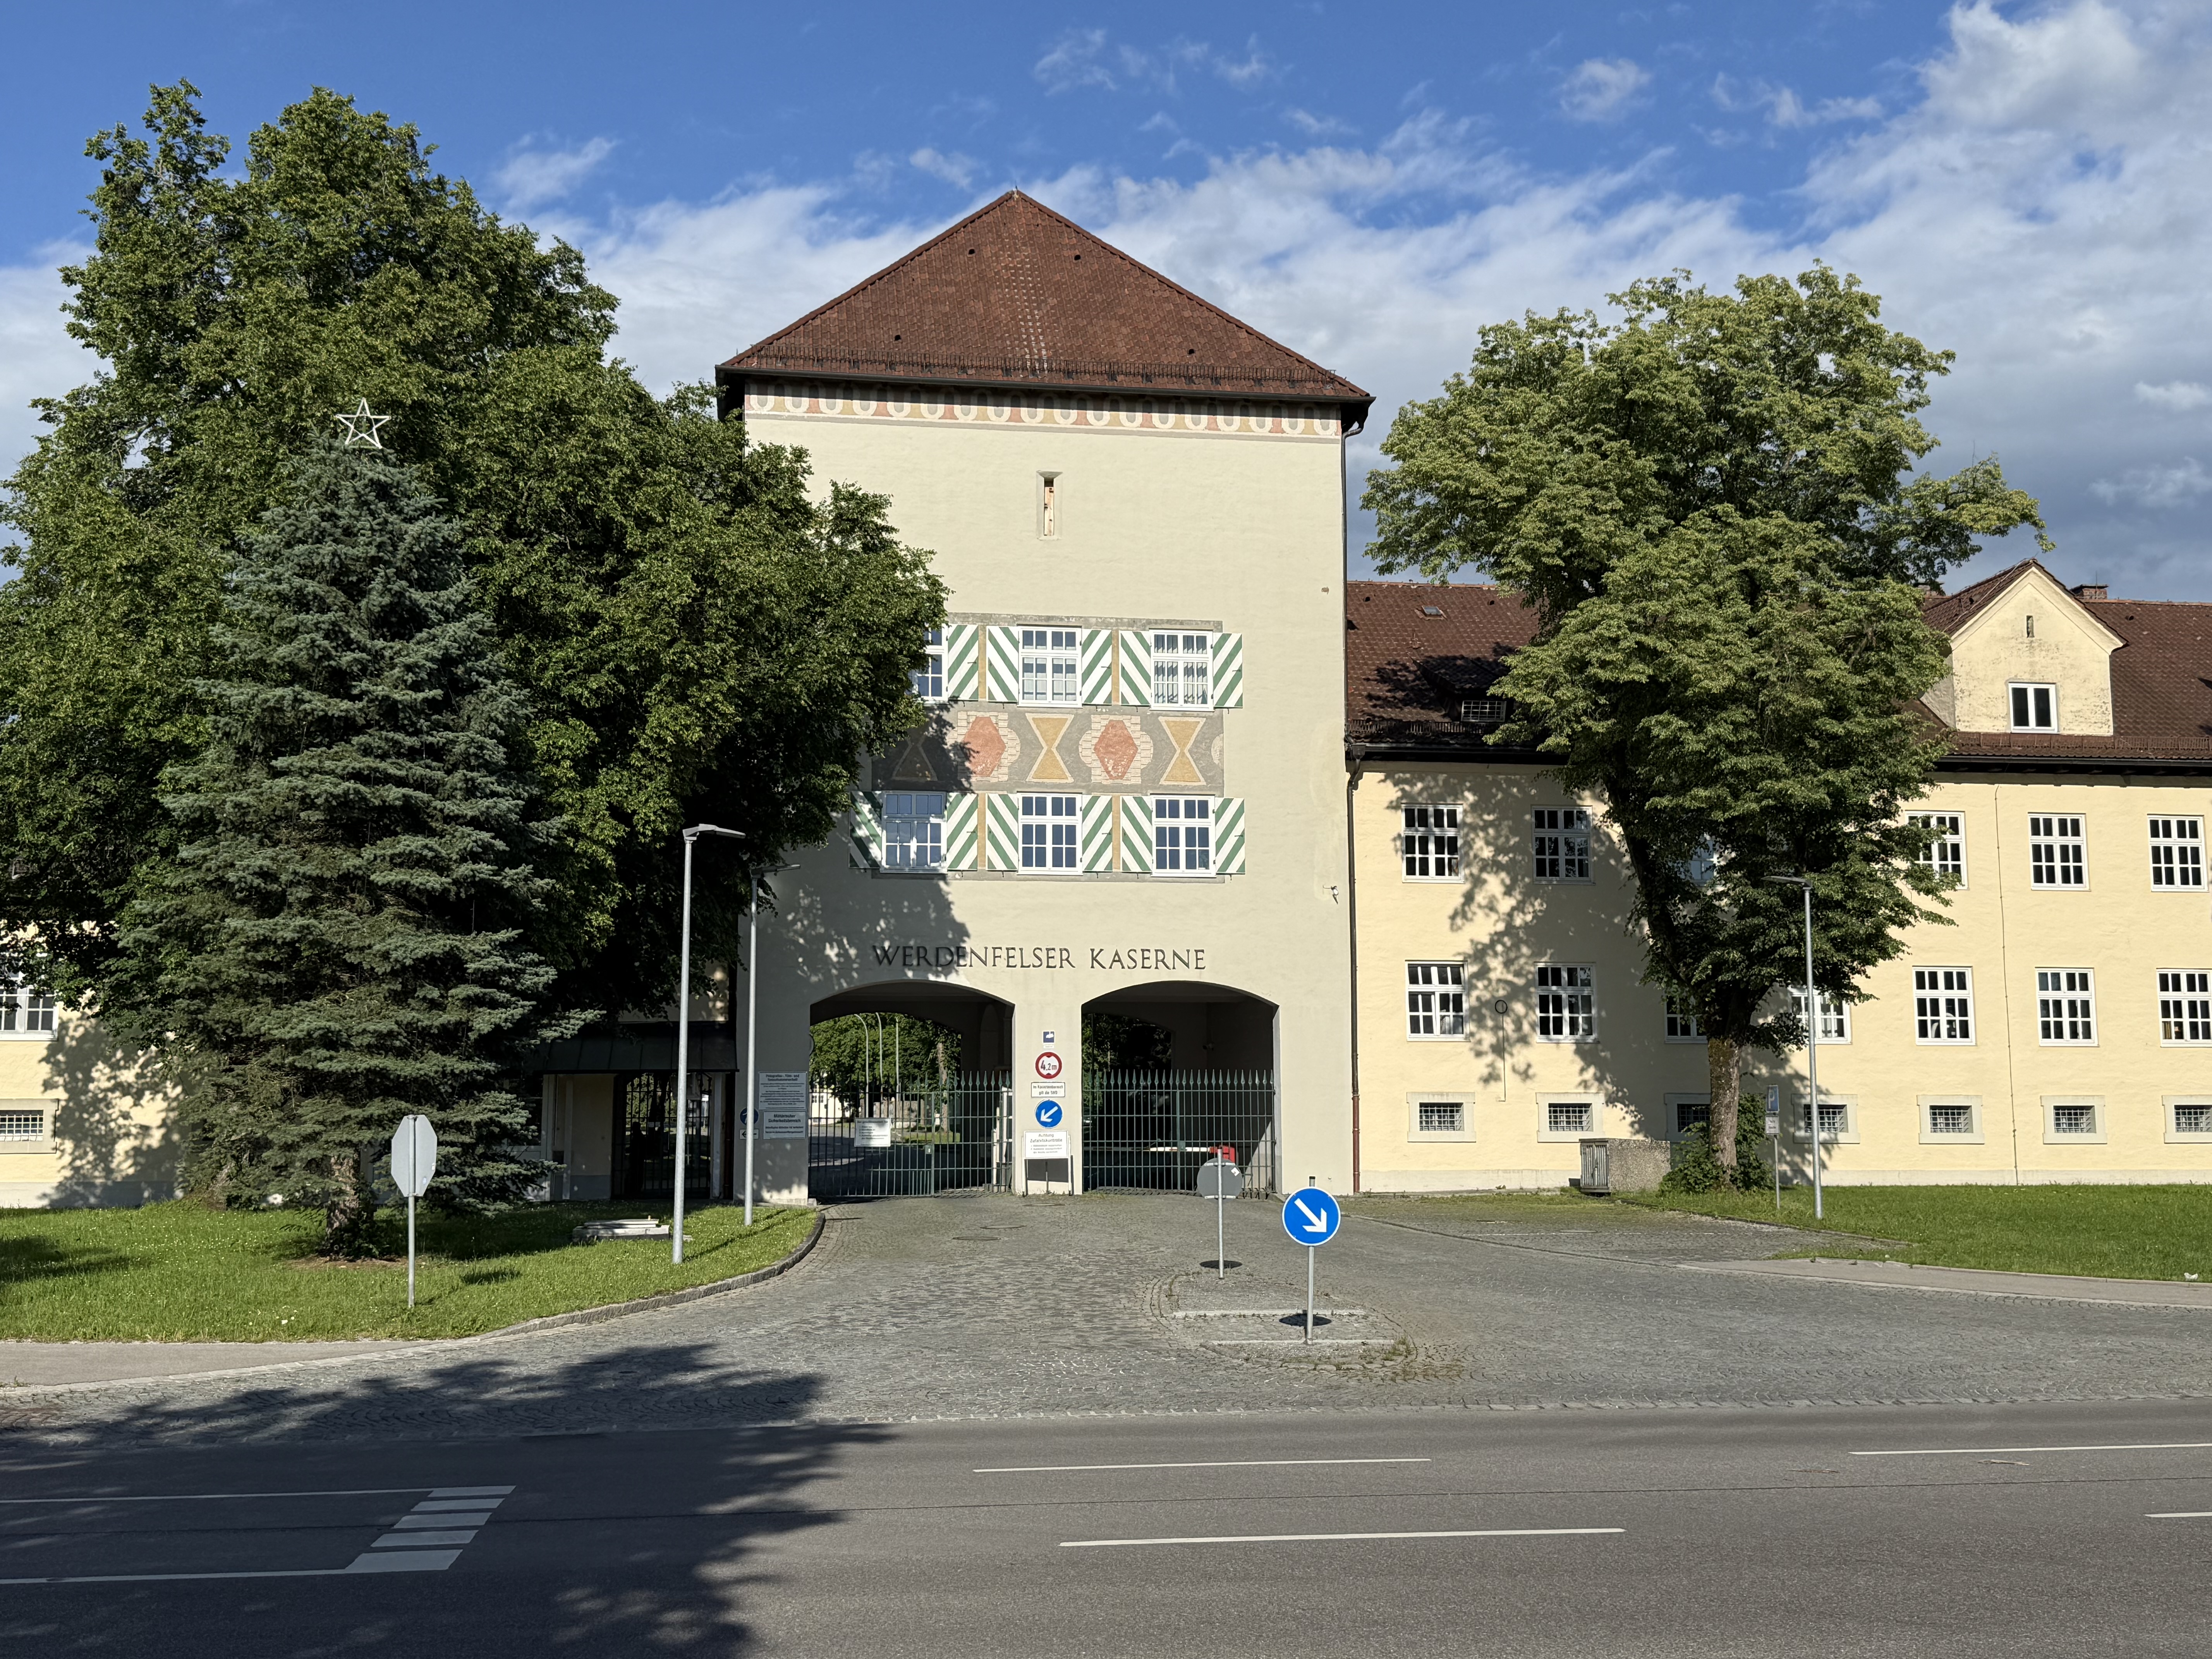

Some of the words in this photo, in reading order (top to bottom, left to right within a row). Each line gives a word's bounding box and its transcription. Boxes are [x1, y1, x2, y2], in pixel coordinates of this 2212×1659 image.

[873, 945, 1075, 968] WERDENFELSER
[1090, 948, 1206, 969] KASERNE
[1769, 1089, 1774, 1109] P
